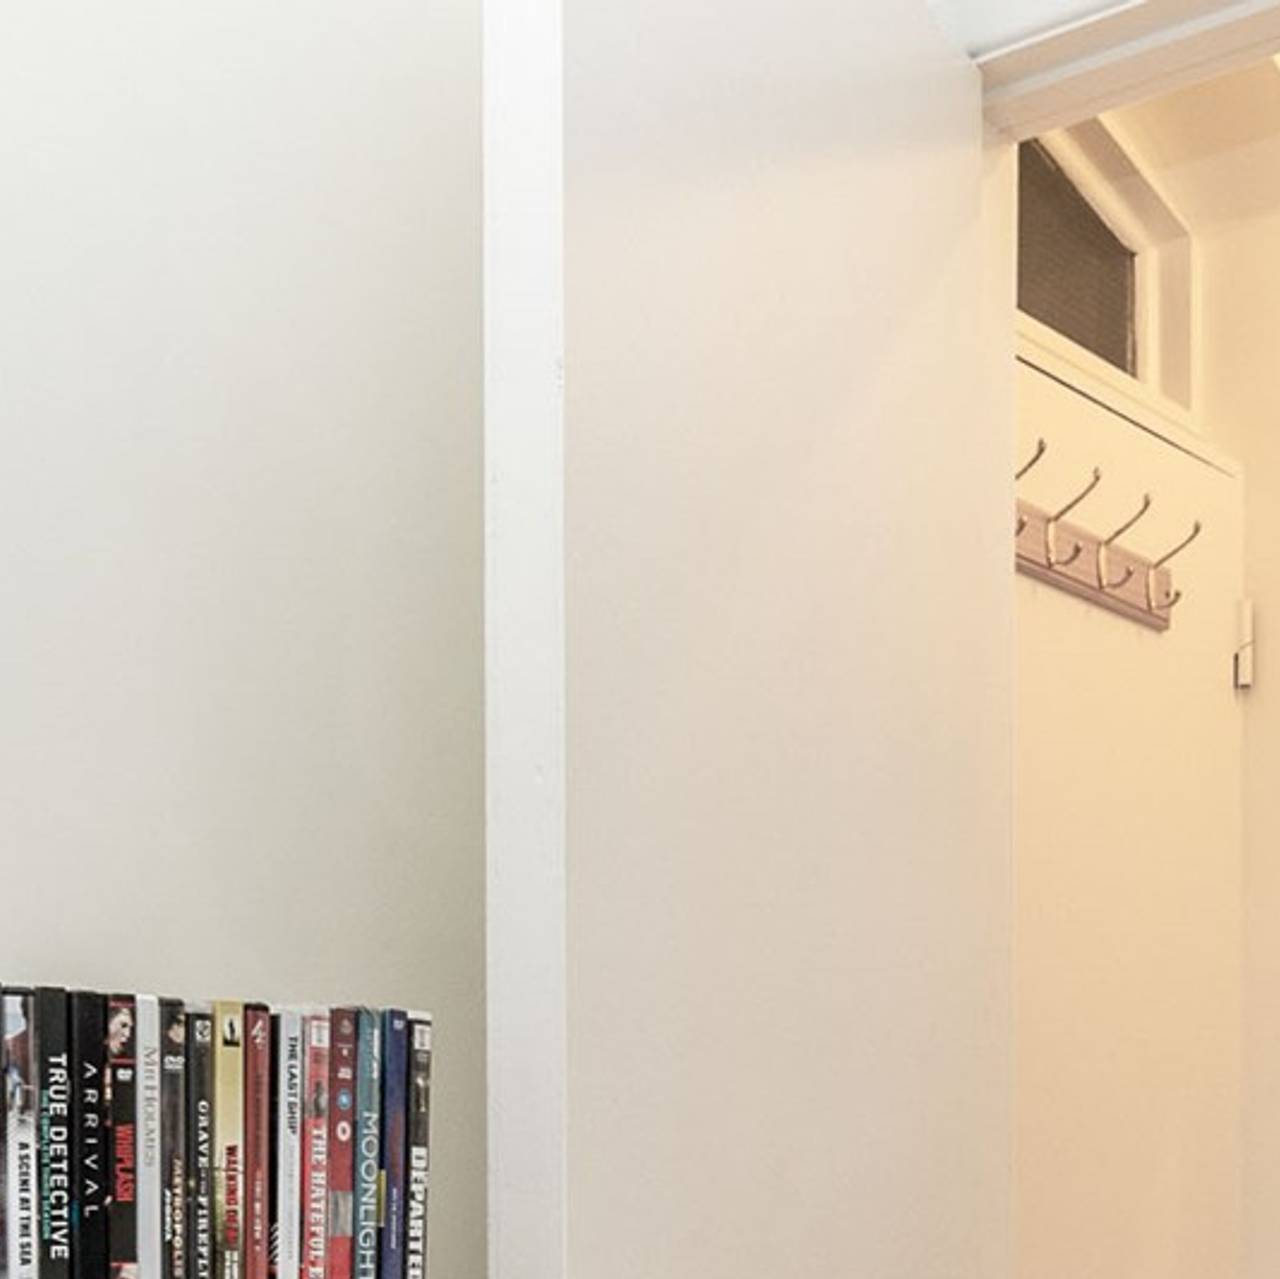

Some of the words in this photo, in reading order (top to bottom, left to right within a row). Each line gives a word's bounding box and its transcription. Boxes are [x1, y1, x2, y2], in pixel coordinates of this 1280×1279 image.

[288, 1035, 298, 1060] THE
[49, 1053, 68, 1116] TRUE
[287, 1064, 298, 1099] LAST
[197, 1100, 209, 1169] GRAVE
[287, 1101, 299, 1135] SHIP
[18, 1141, 30, 1149] A
[82, 1062, 99, 1218] ARRIVAL
[311, 1126, 328, 1165] THE
[18, 1153, 32, 1195] SCENE
[115, 1123, 134, 1203] WHIPLASH
[223, 1145, 240, 1206] WALKING
[19, 1197, 32, 1212] AT
[49, 1125, 69, 1259] DETECTIVE
[19, 1215, 32, 1238] THE
[173, 1158, 183, 1279] METROPOLIS
[308, 1171, 327, 1260] HATEFUL
[19, 1240, 33, 1266] SEA
